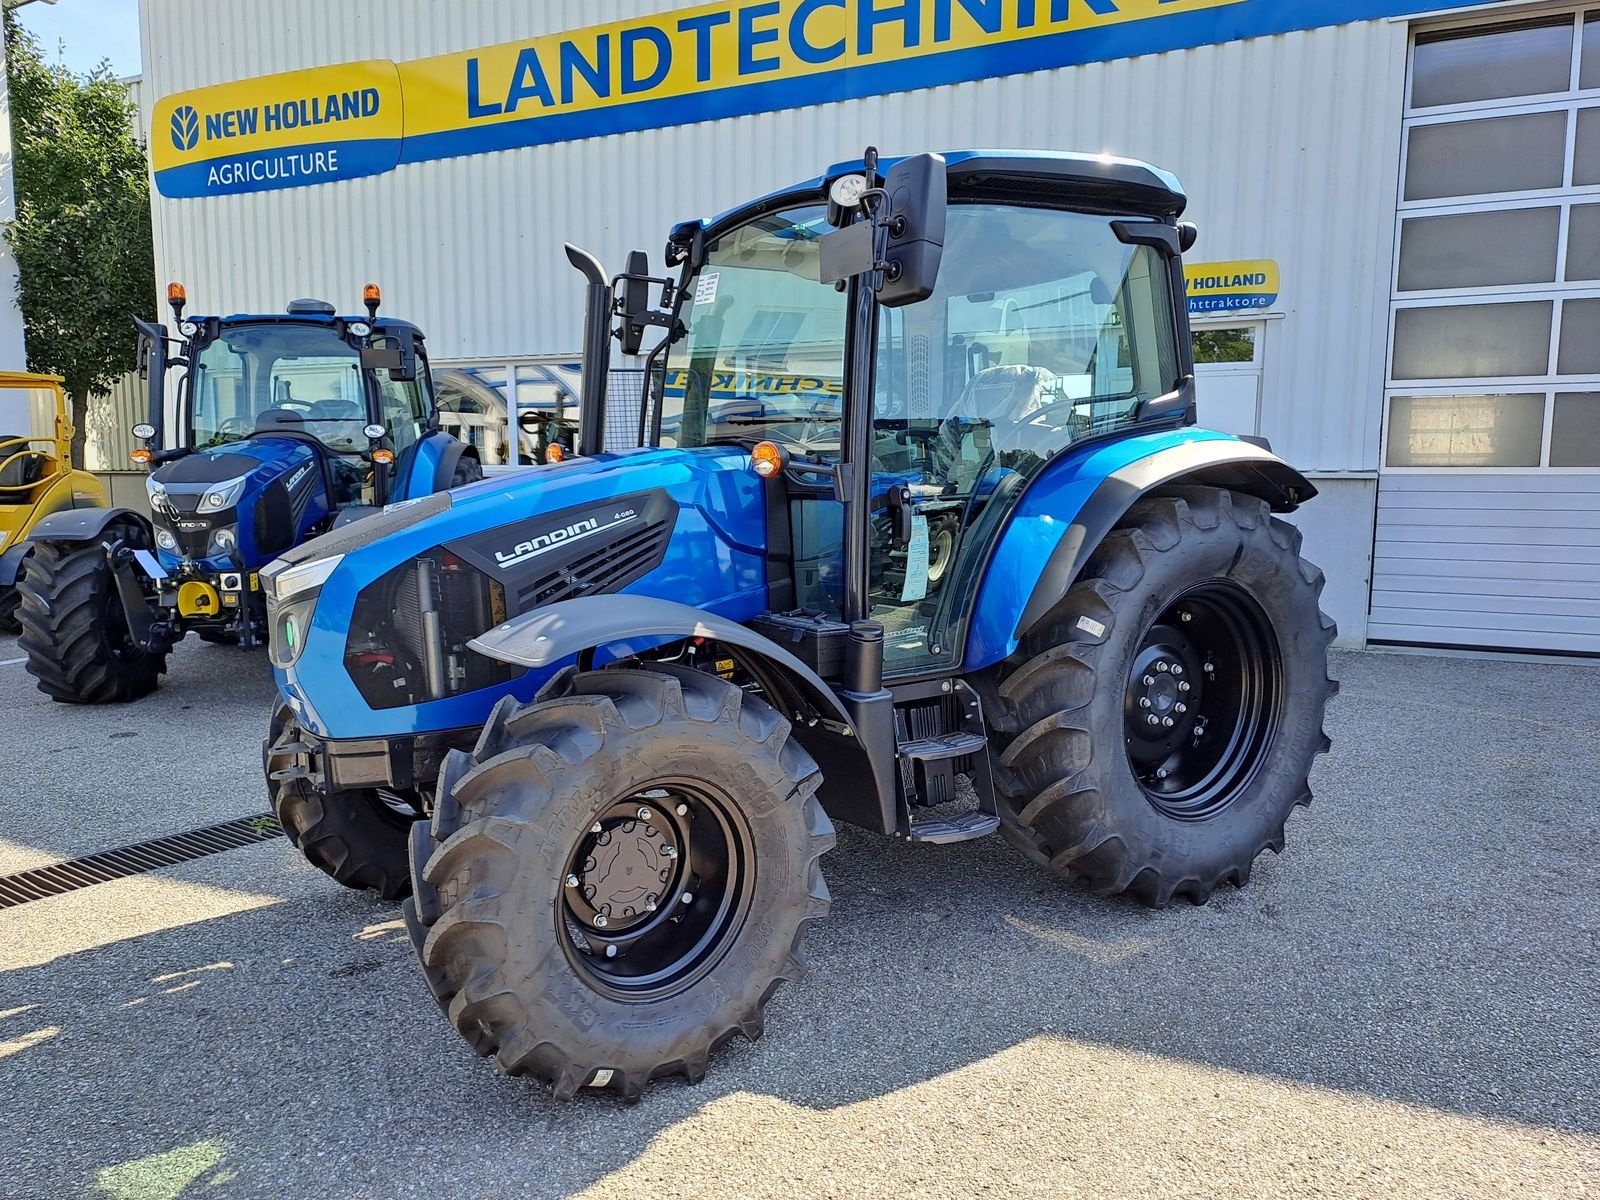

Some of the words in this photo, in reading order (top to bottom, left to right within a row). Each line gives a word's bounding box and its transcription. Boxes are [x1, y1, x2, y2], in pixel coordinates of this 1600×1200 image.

[205, 107, 258, 141] NEW
[264, 88, 380, 131] HOLLAND
[207, 149, 338, 186] AGRICULTURE
[1193, 273, 1266, 289] HOLLAND
[1190, 297, 1267, 310] httraktore
[495, 518, 598, 562] LANDINI
